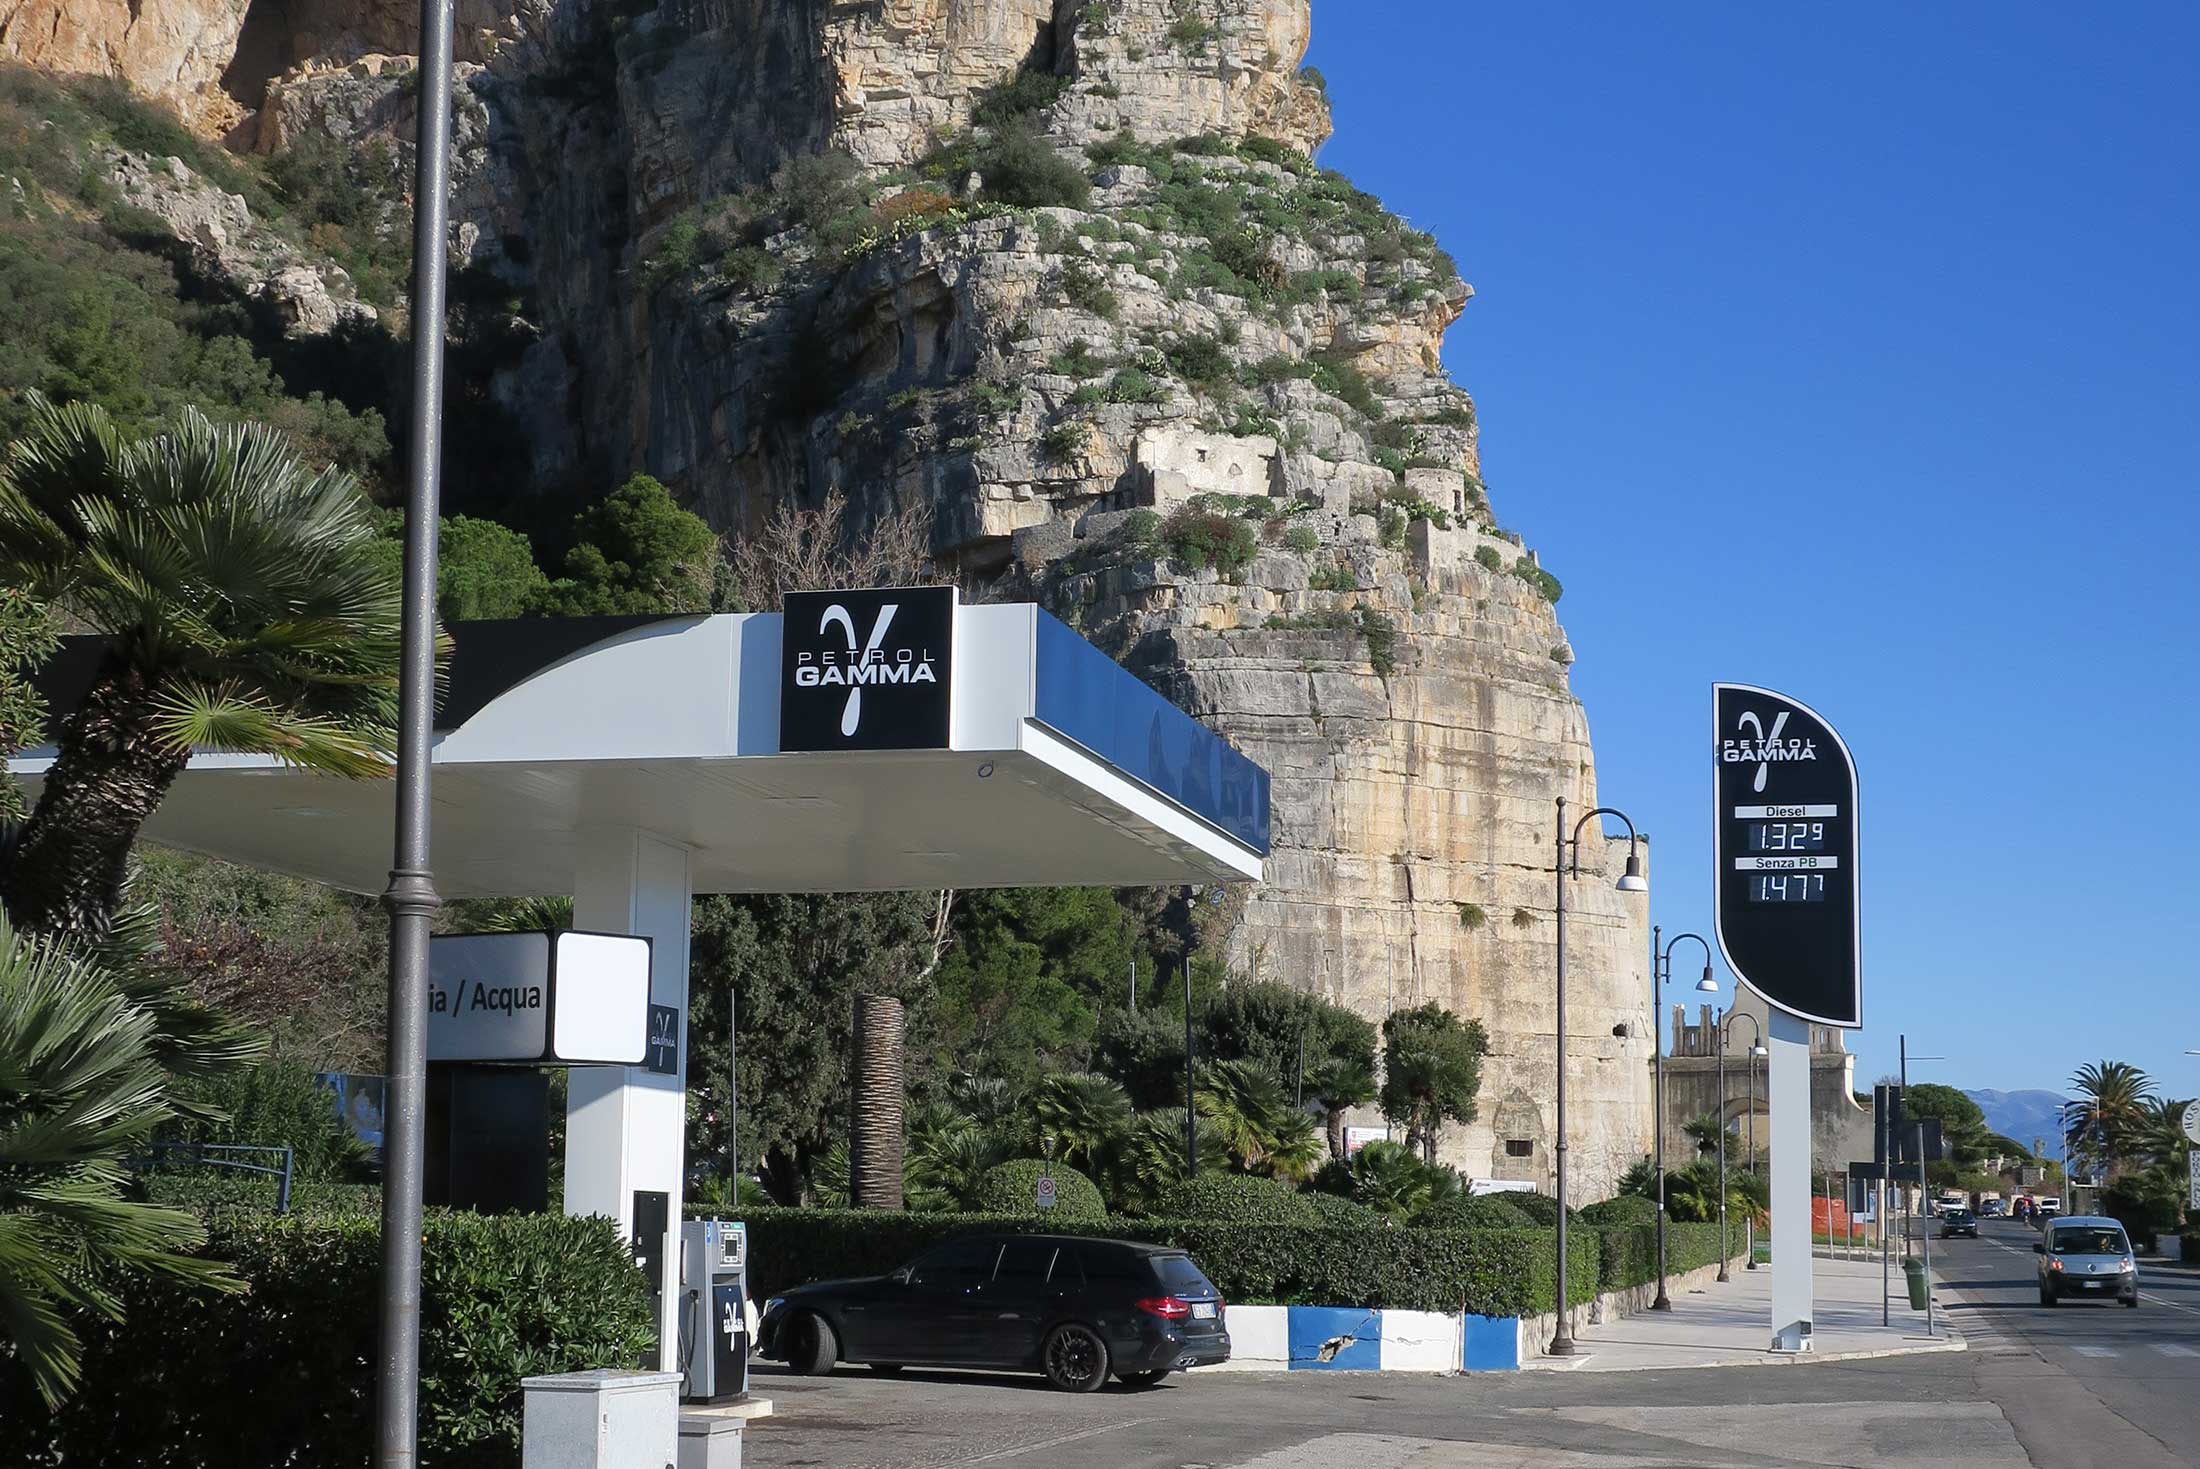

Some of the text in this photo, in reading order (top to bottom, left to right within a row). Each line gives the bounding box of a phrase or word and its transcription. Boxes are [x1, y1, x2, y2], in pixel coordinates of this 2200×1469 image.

[798, 649, 935, 665] PETROL
[796, 663, 936, 686] GAMMA
[1723, 738, 1816, 749] PETROL
[1723, 748, 1817, 762] GAMMA
[1766, 806, 1806, 817] Diesel
[1761, 823, 1823, 849] 1.329
[1756, 858, 1818, 868] Senza PB
[1761, 874, 1823, 900] 1.477
[428, 984, 447, 1012] ia
[471, 982, 540, 1016] Acqua
[2184, 1101, 2200, 1130] HOS
